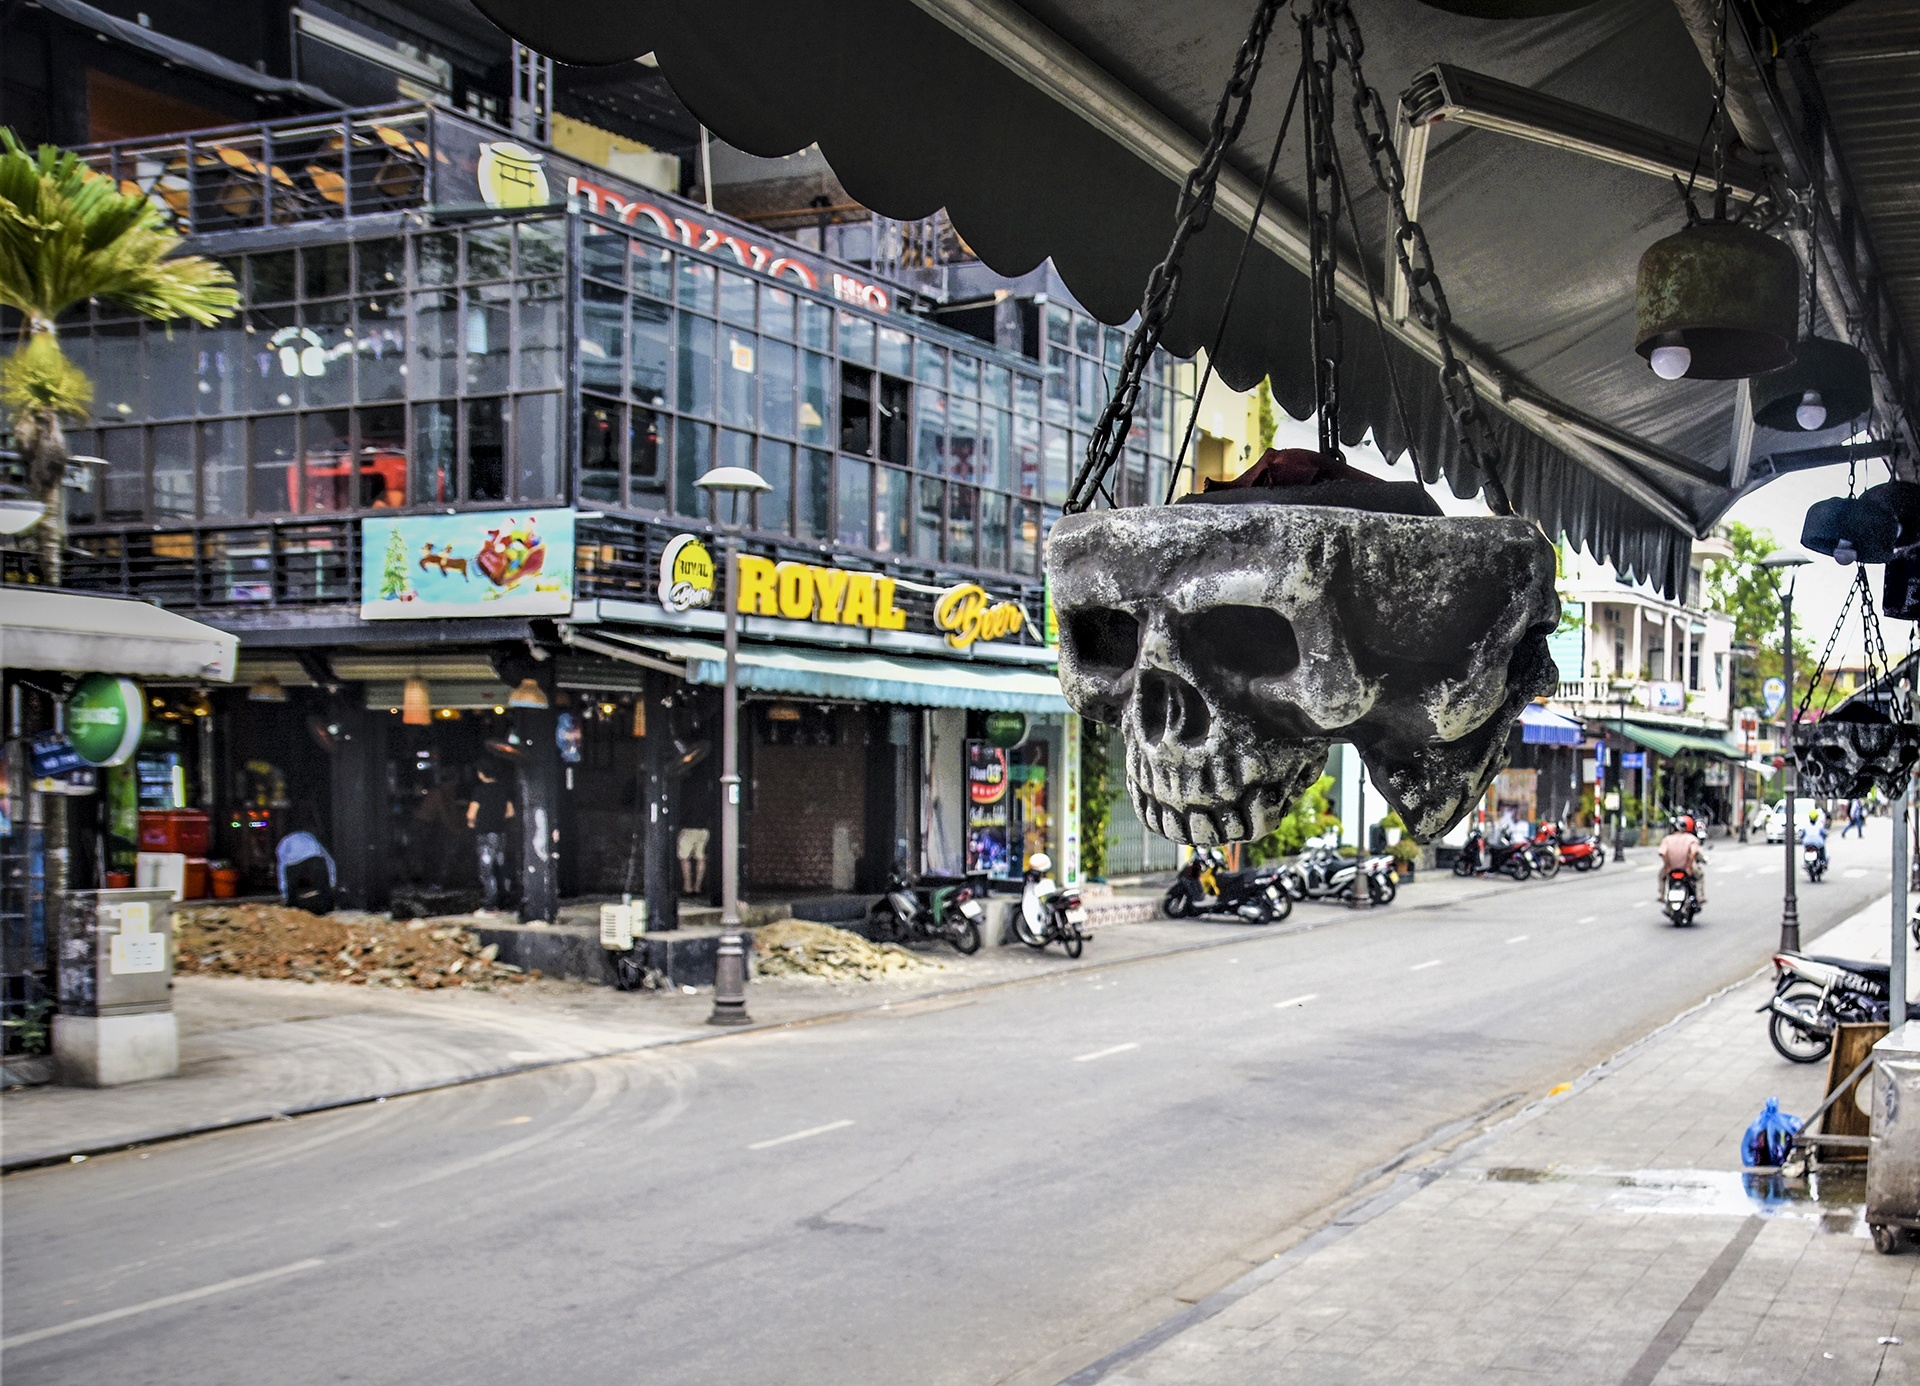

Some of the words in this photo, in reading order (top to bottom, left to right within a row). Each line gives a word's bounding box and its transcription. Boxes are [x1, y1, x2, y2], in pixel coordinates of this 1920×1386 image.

[680, 560, 709, 578] ROYAL
[736, 555, 907, 630] ROYAL
[936, 583, 1023, 649] Beer
